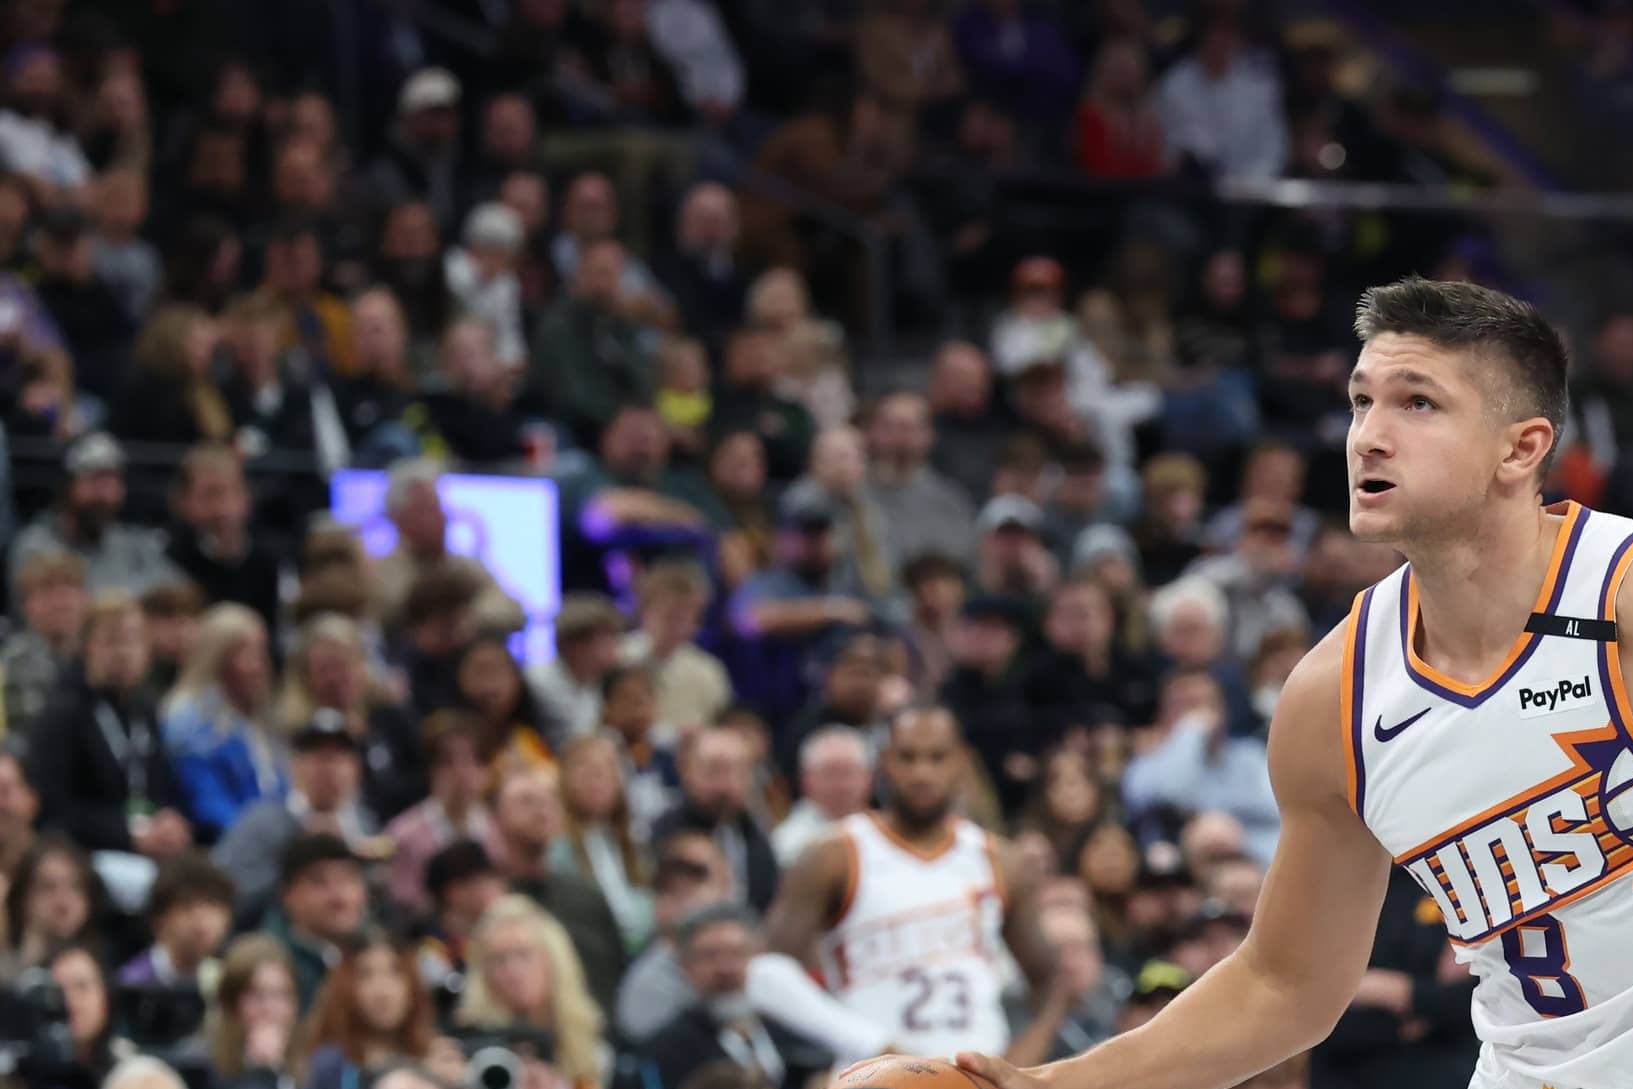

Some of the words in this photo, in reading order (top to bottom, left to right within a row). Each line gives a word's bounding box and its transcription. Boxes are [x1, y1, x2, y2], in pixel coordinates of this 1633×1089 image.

[1565, 620, 1580, 636] AL
[1518, 675, 1592, 711] PayPal
[1402, 787, 1606, 942] UNS
[900, 963, 971, 1031] 23
[1499, 912, 1589, 1019] 8
